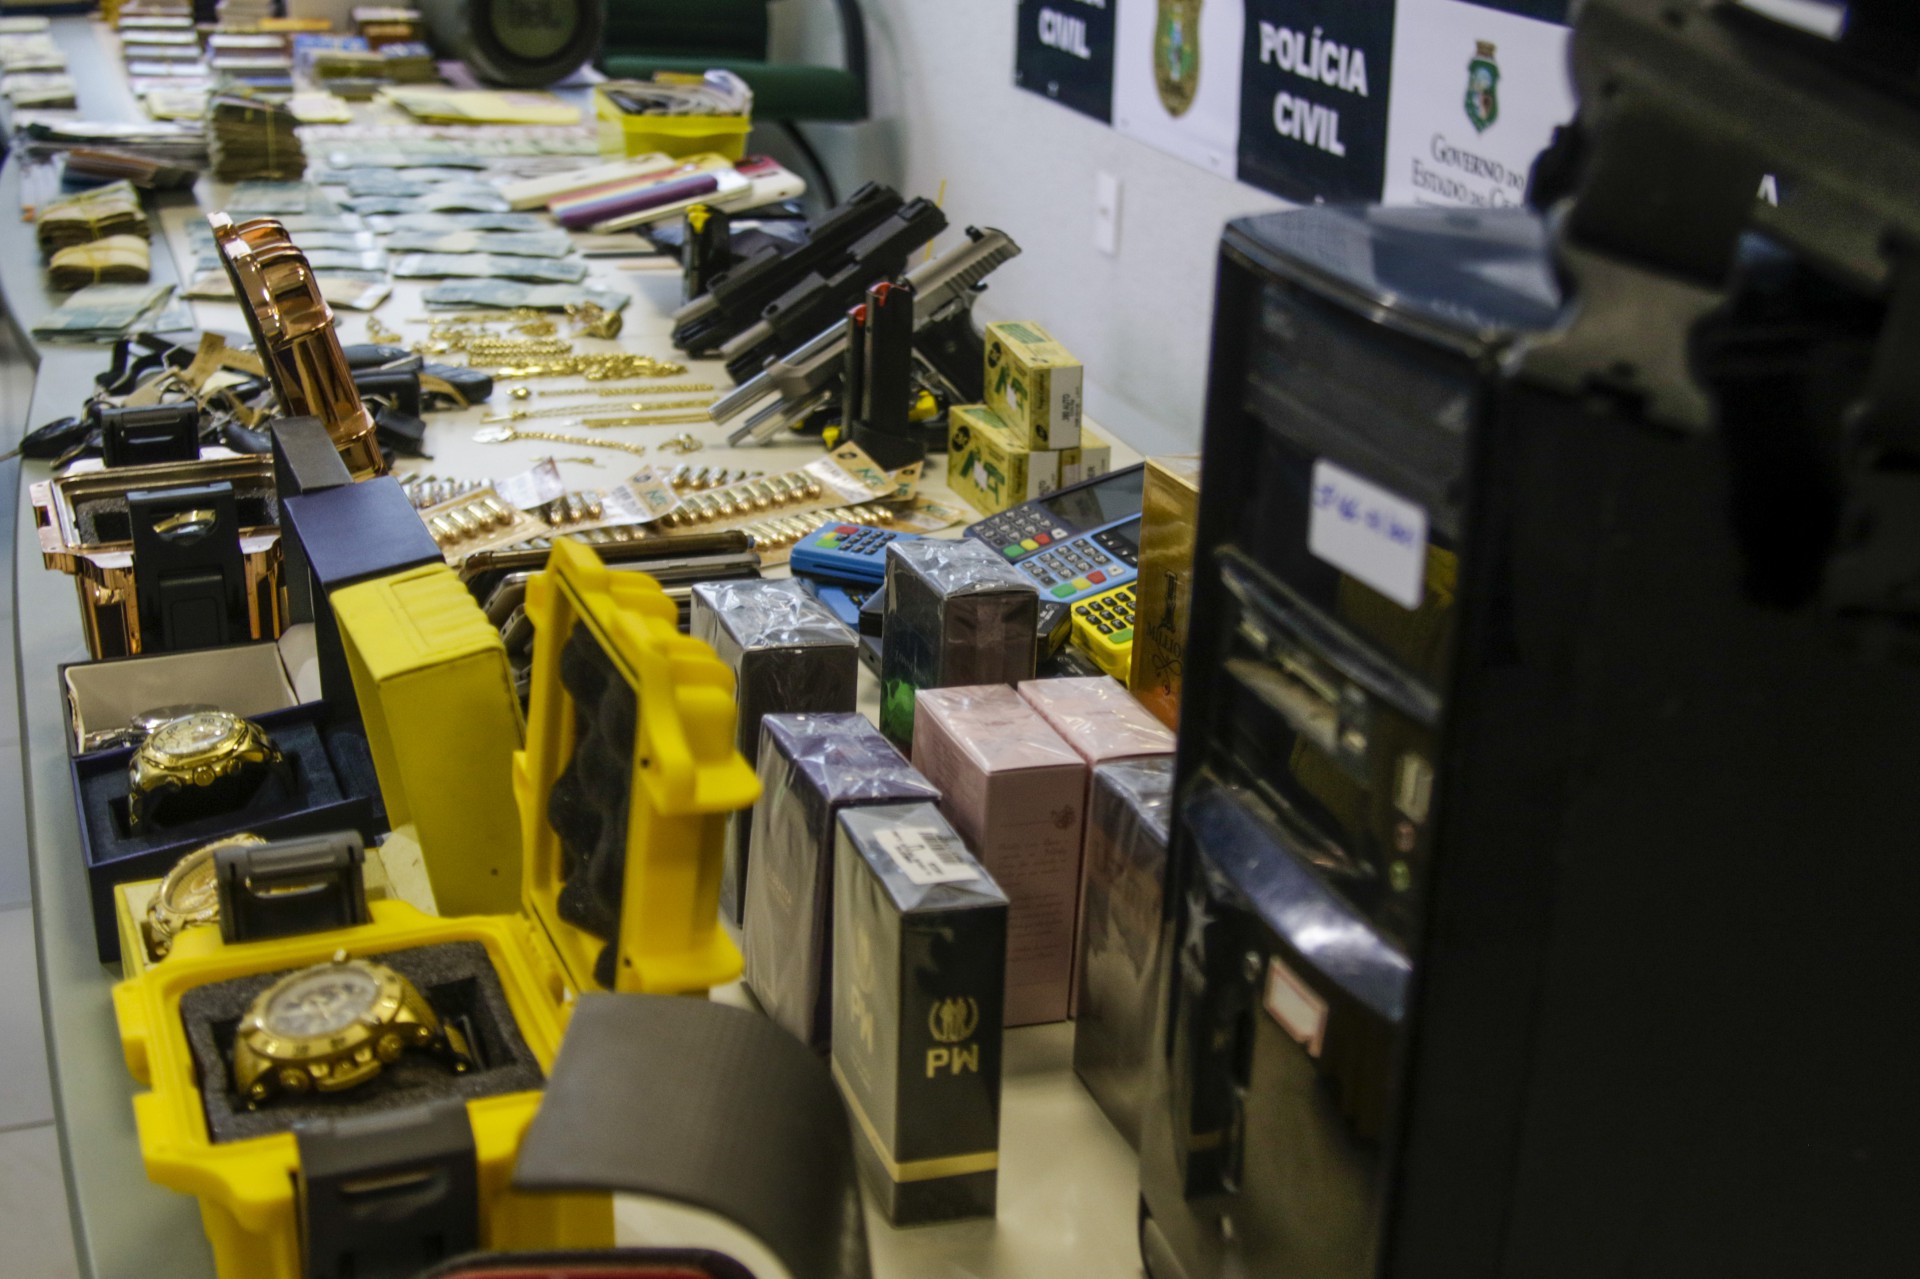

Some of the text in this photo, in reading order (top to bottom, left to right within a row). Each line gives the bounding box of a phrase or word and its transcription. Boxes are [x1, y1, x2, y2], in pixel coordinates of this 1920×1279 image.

[1038, 7, 1091, 60] CIVIL
[1259, 20, 1368, 97] POLÍCIA
[1273, 91, 1346, 157] CIVIL
